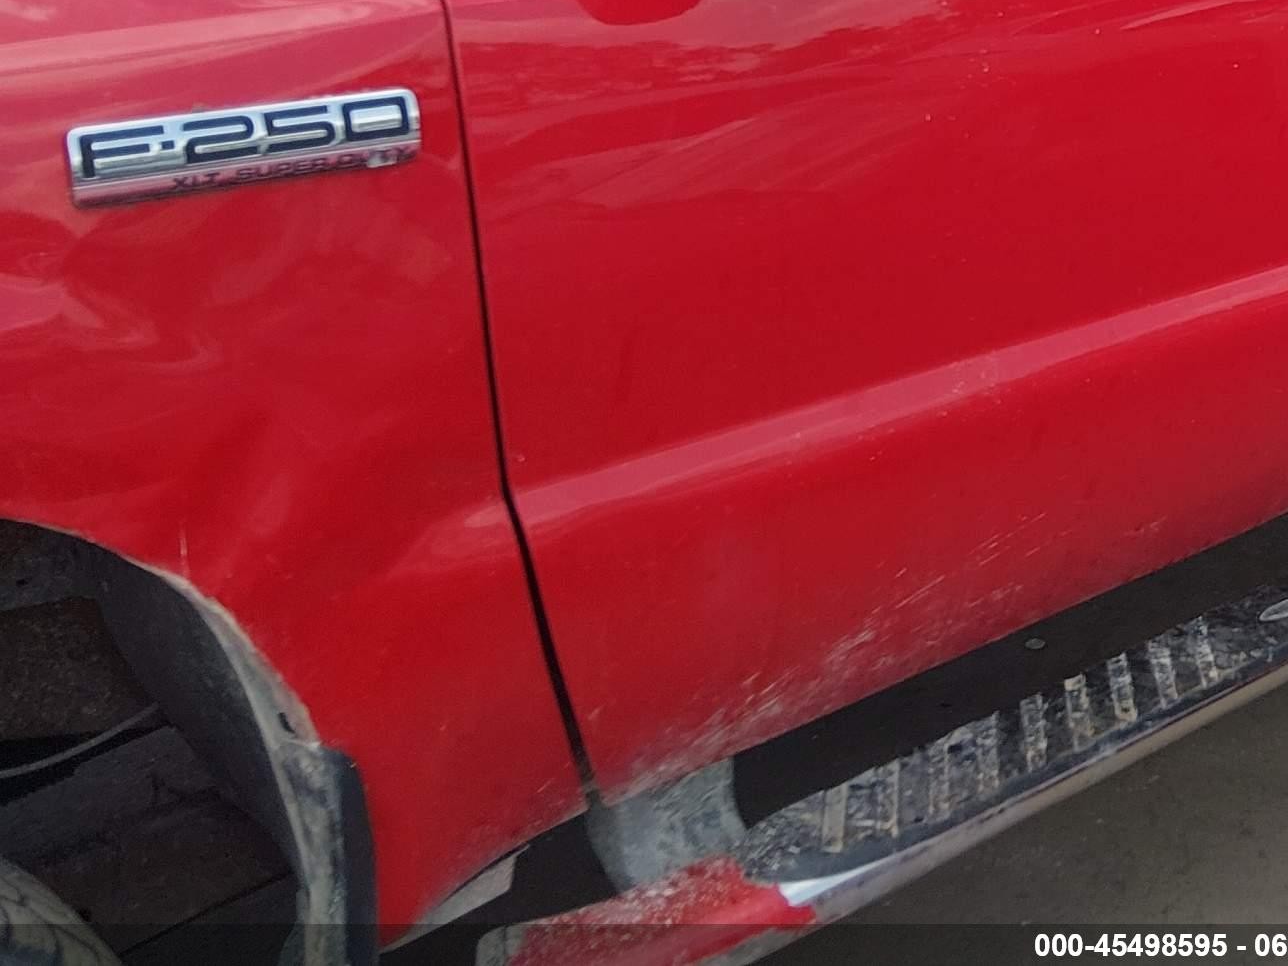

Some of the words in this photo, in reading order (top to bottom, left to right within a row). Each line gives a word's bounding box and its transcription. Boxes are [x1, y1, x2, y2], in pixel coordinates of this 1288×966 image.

[79, 95, 410, 178] F-250
[172, 172, 220, 190] XLT
[235, 156, 331, 183] SUPER
